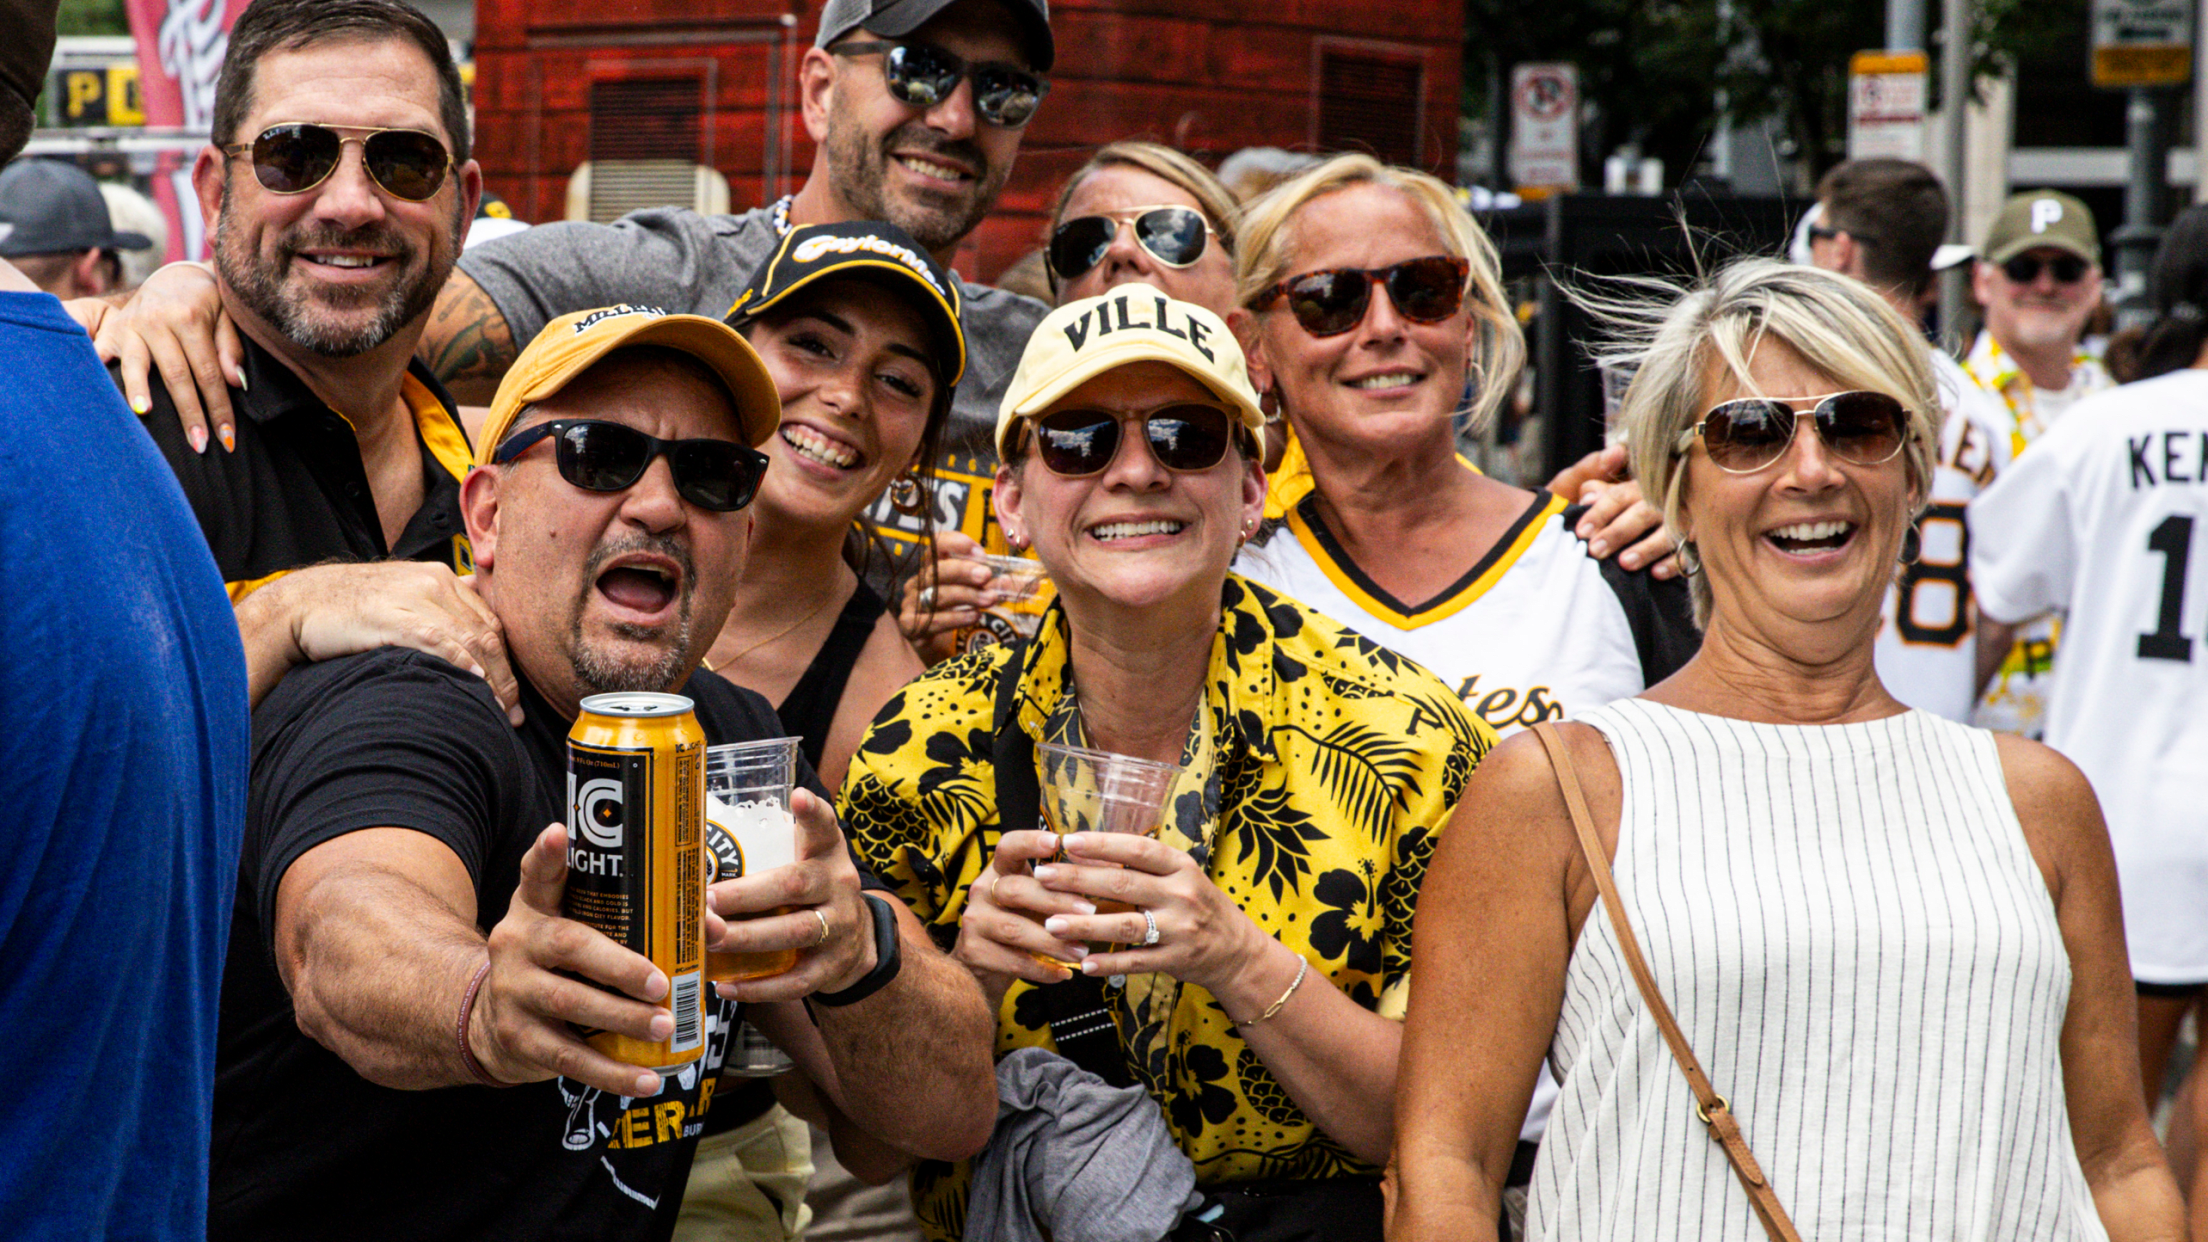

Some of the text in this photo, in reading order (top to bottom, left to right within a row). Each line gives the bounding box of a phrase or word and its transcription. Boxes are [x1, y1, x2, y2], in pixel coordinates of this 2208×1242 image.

[2032, 199, 2063, 234] P
[1063, 296, 1215, 366] VILLE
[567, 771, 623, 848] IC
[600, 892, 629, 900] EMBODIES
[683, 1121, 704, 1138] BUR
